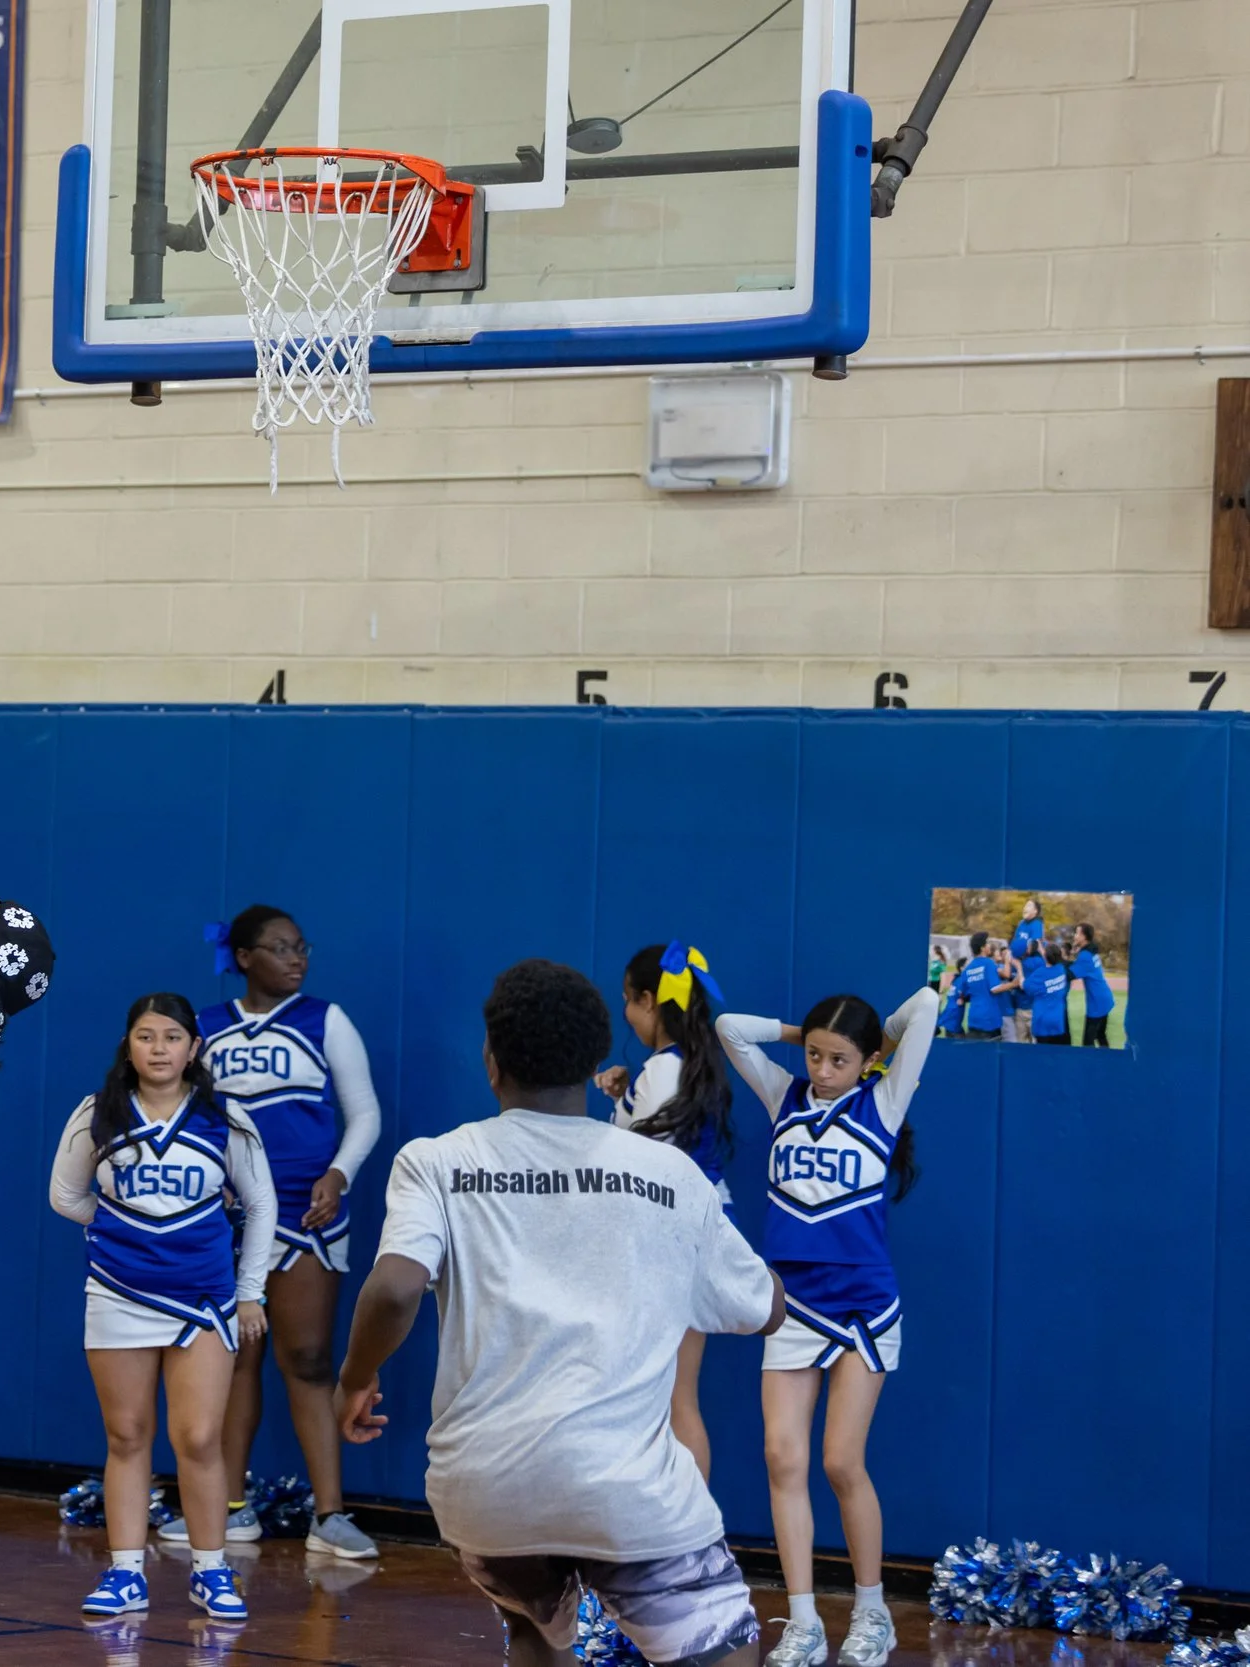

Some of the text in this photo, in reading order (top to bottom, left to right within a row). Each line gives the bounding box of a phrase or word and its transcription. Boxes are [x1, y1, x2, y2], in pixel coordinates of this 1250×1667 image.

[1188, 670, 1227, 710] 7
[211, 1046, 290, 1080] MS50
[112, 1164, 205, 1201] MS50
[774, 1145, 861, 1191] MS50
[450, 1168, 675, 1209] Jahsaiah Watson
